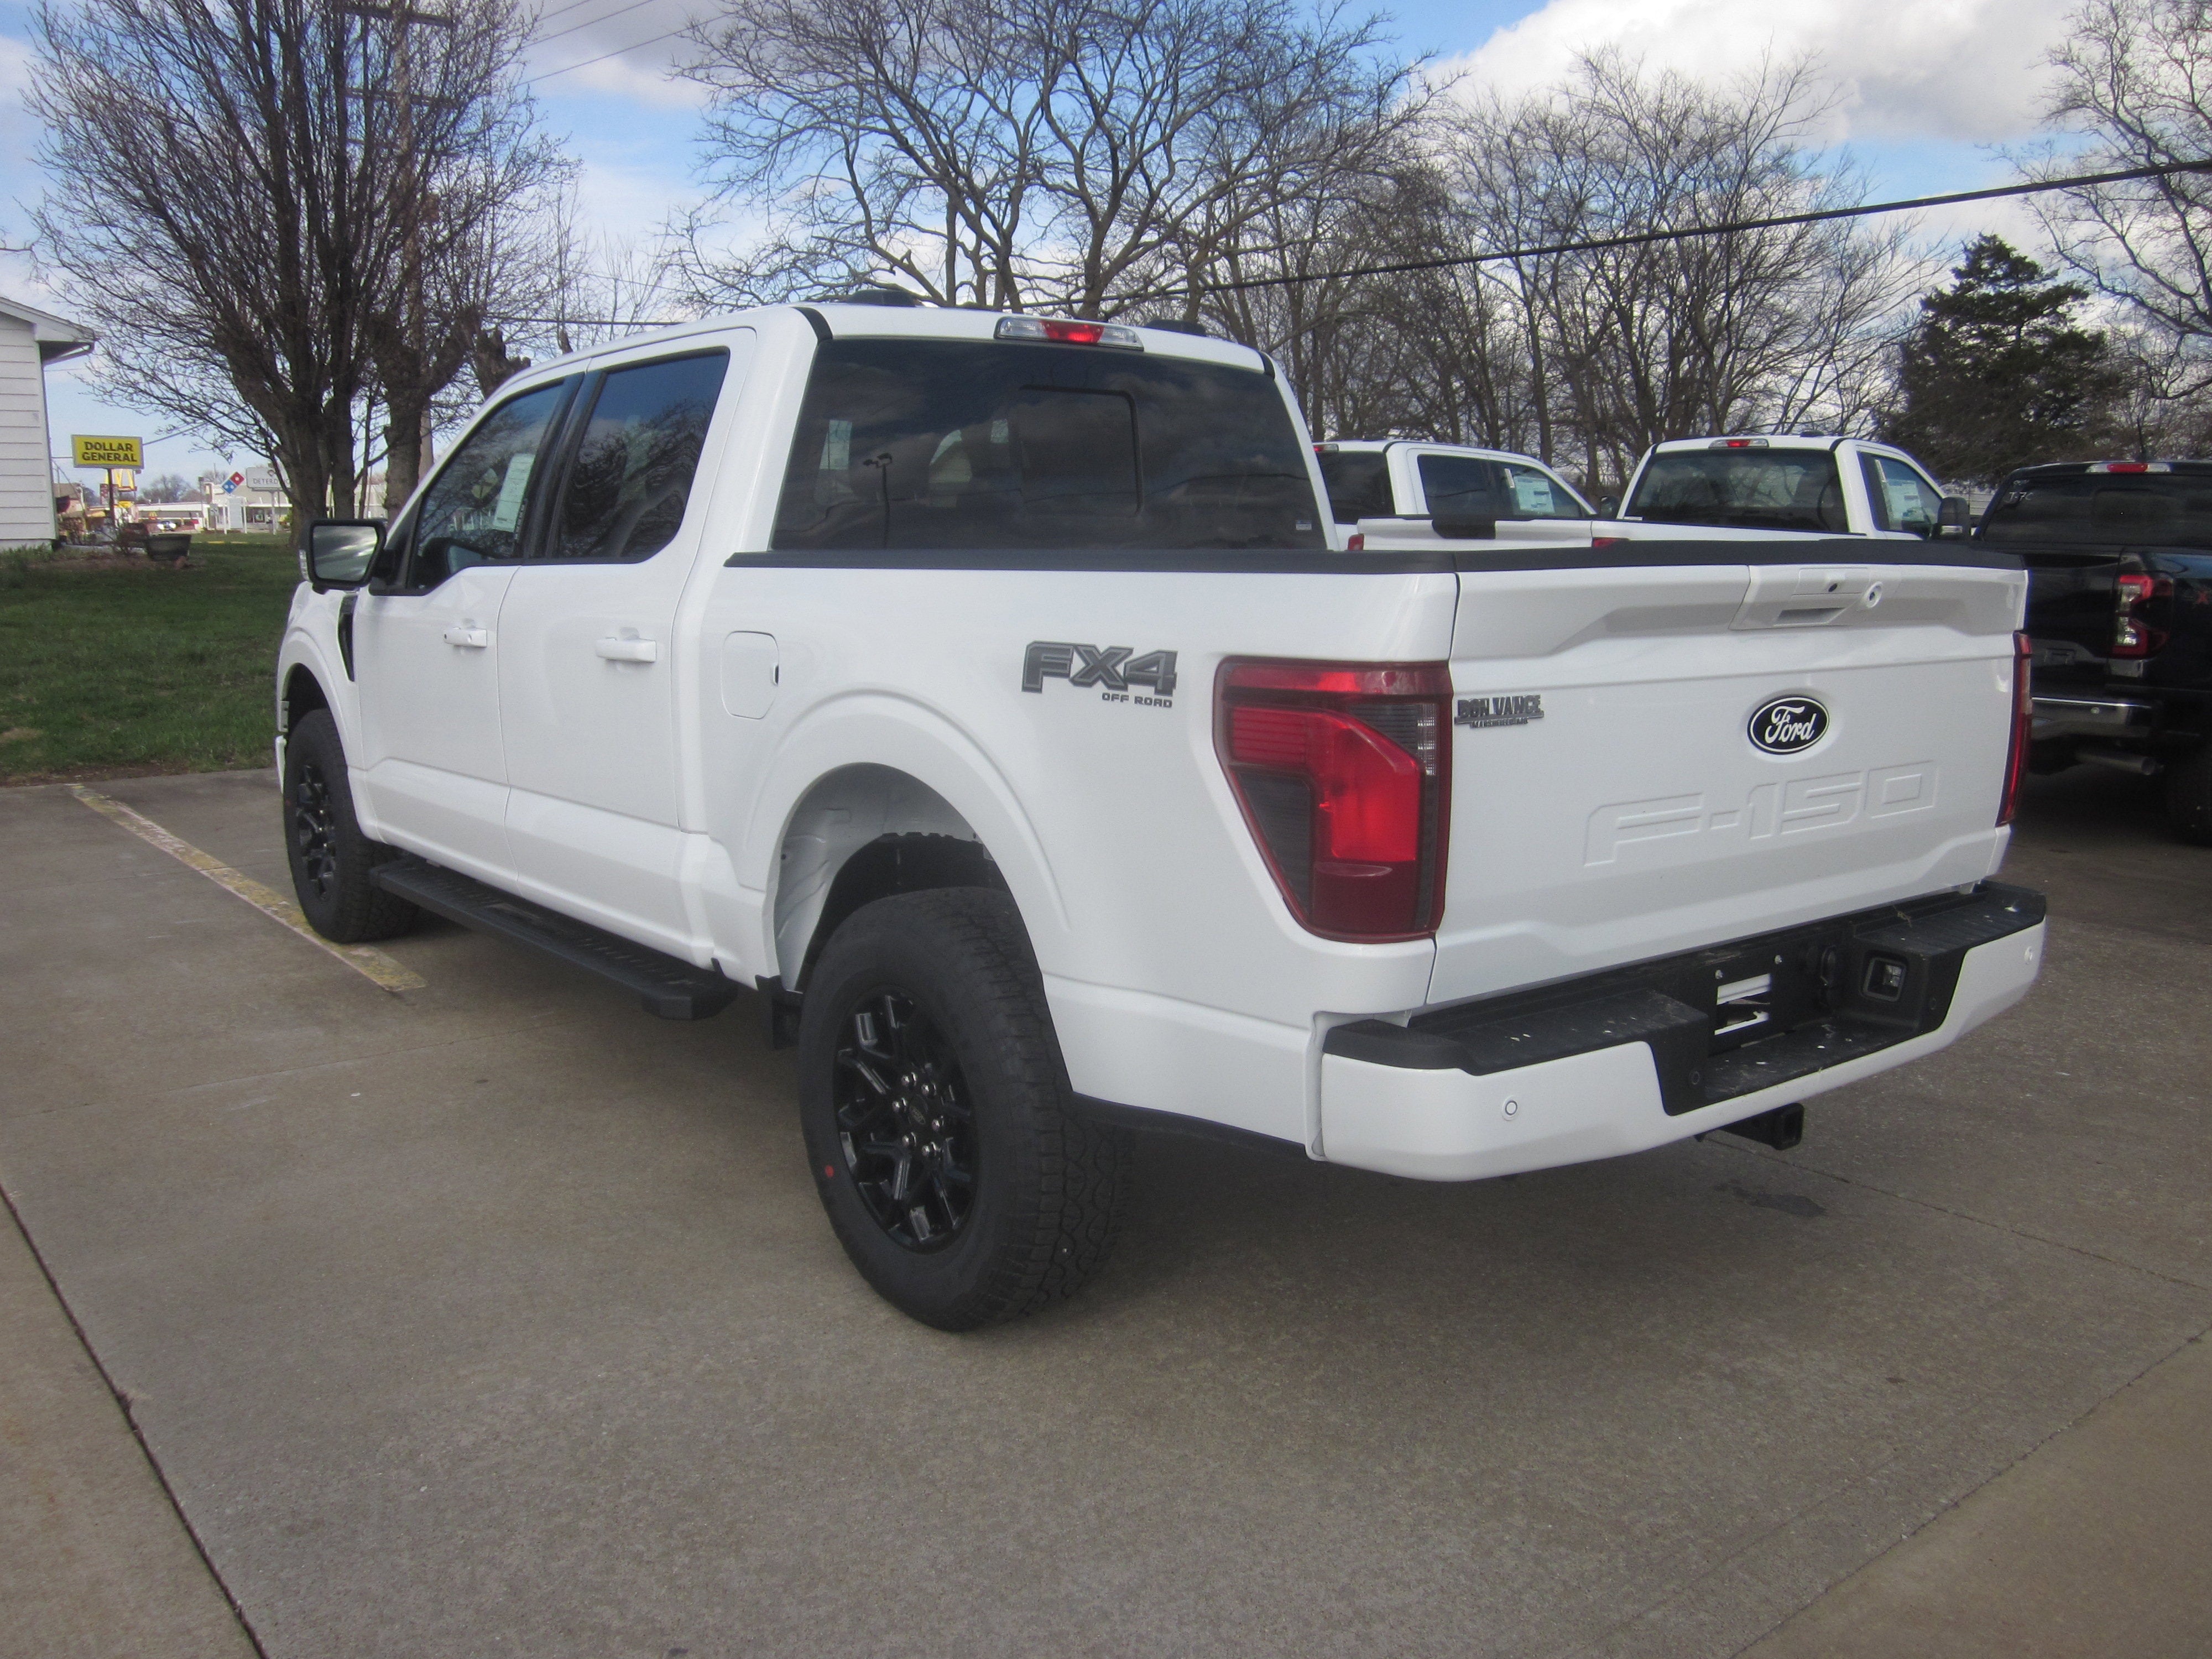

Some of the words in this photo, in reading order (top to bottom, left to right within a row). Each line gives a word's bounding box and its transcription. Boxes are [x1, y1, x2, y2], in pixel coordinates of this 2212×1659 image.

[82, 452, 137, 462] GENERAL
[85, 442, 133, 451] DOLLAR
[1021, 640, 1178, 697] FX4
[1102, 692, 1129, 703] OFF
[1134, 695, 1172, 708] ROAD
[1492, 694, 1541, 716] VANCE
[1765, 705, 1817, 744] Ford
[1584, 759, 1934, 867] F-150
